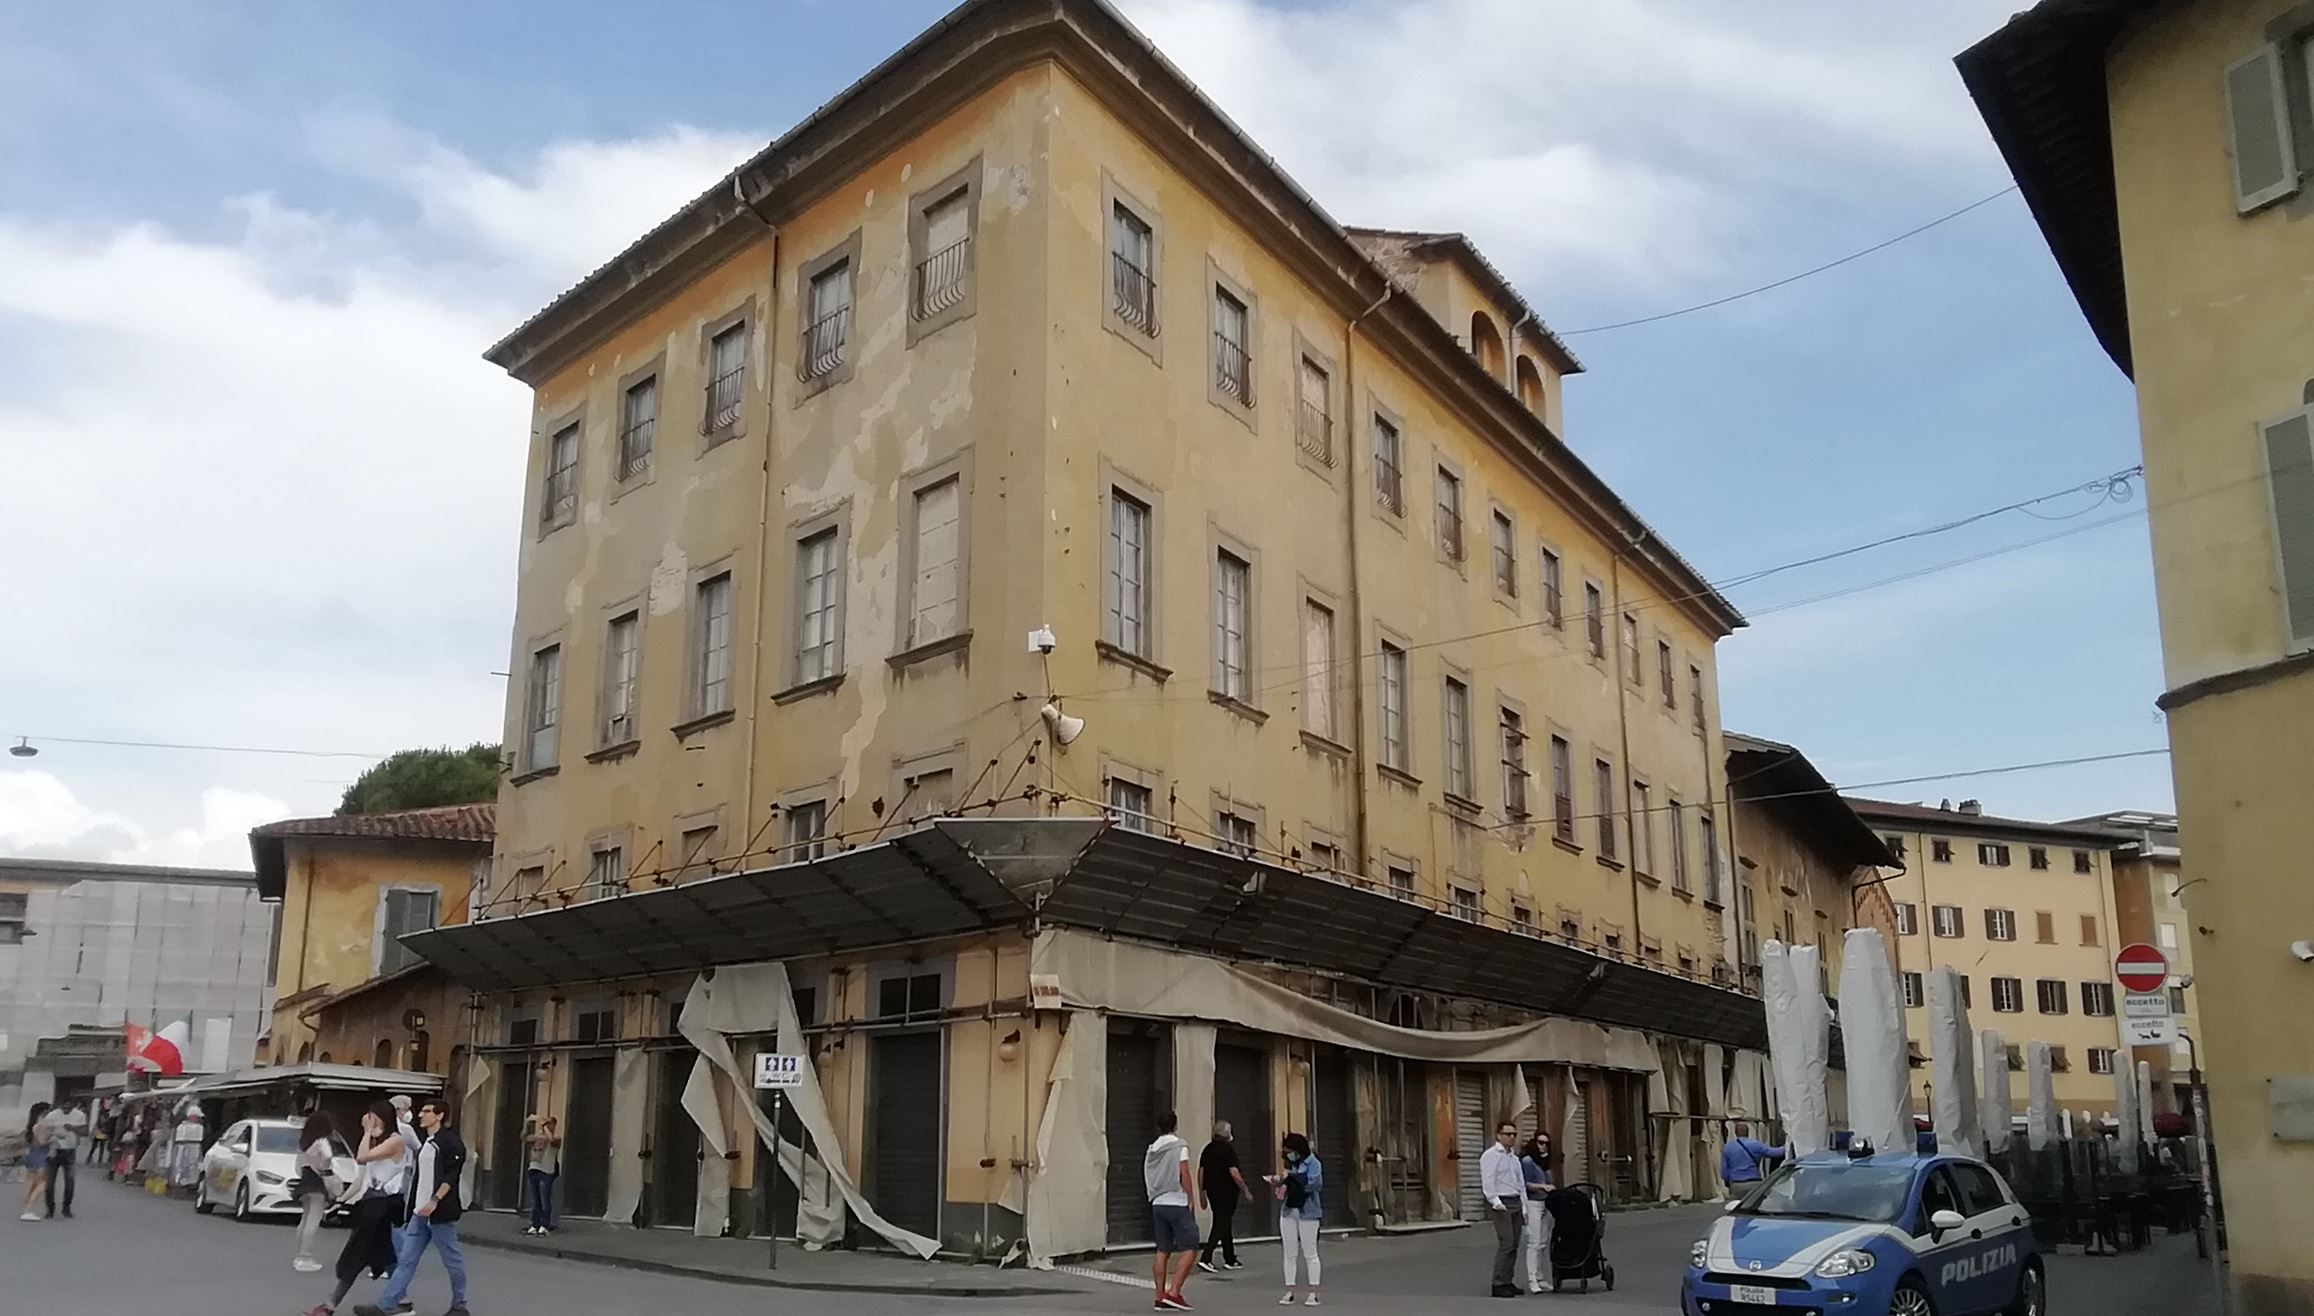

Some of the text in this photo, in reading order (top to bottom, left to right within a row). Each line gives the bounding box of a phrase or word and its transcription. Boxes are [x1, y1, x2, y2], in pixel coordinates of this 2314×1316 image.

[2126, 997, 2165, 1006] eccetto
[2131, 1020, 2165, 1029] eccetto
[1942, 1243, 2016, 1286] POLIZIA
